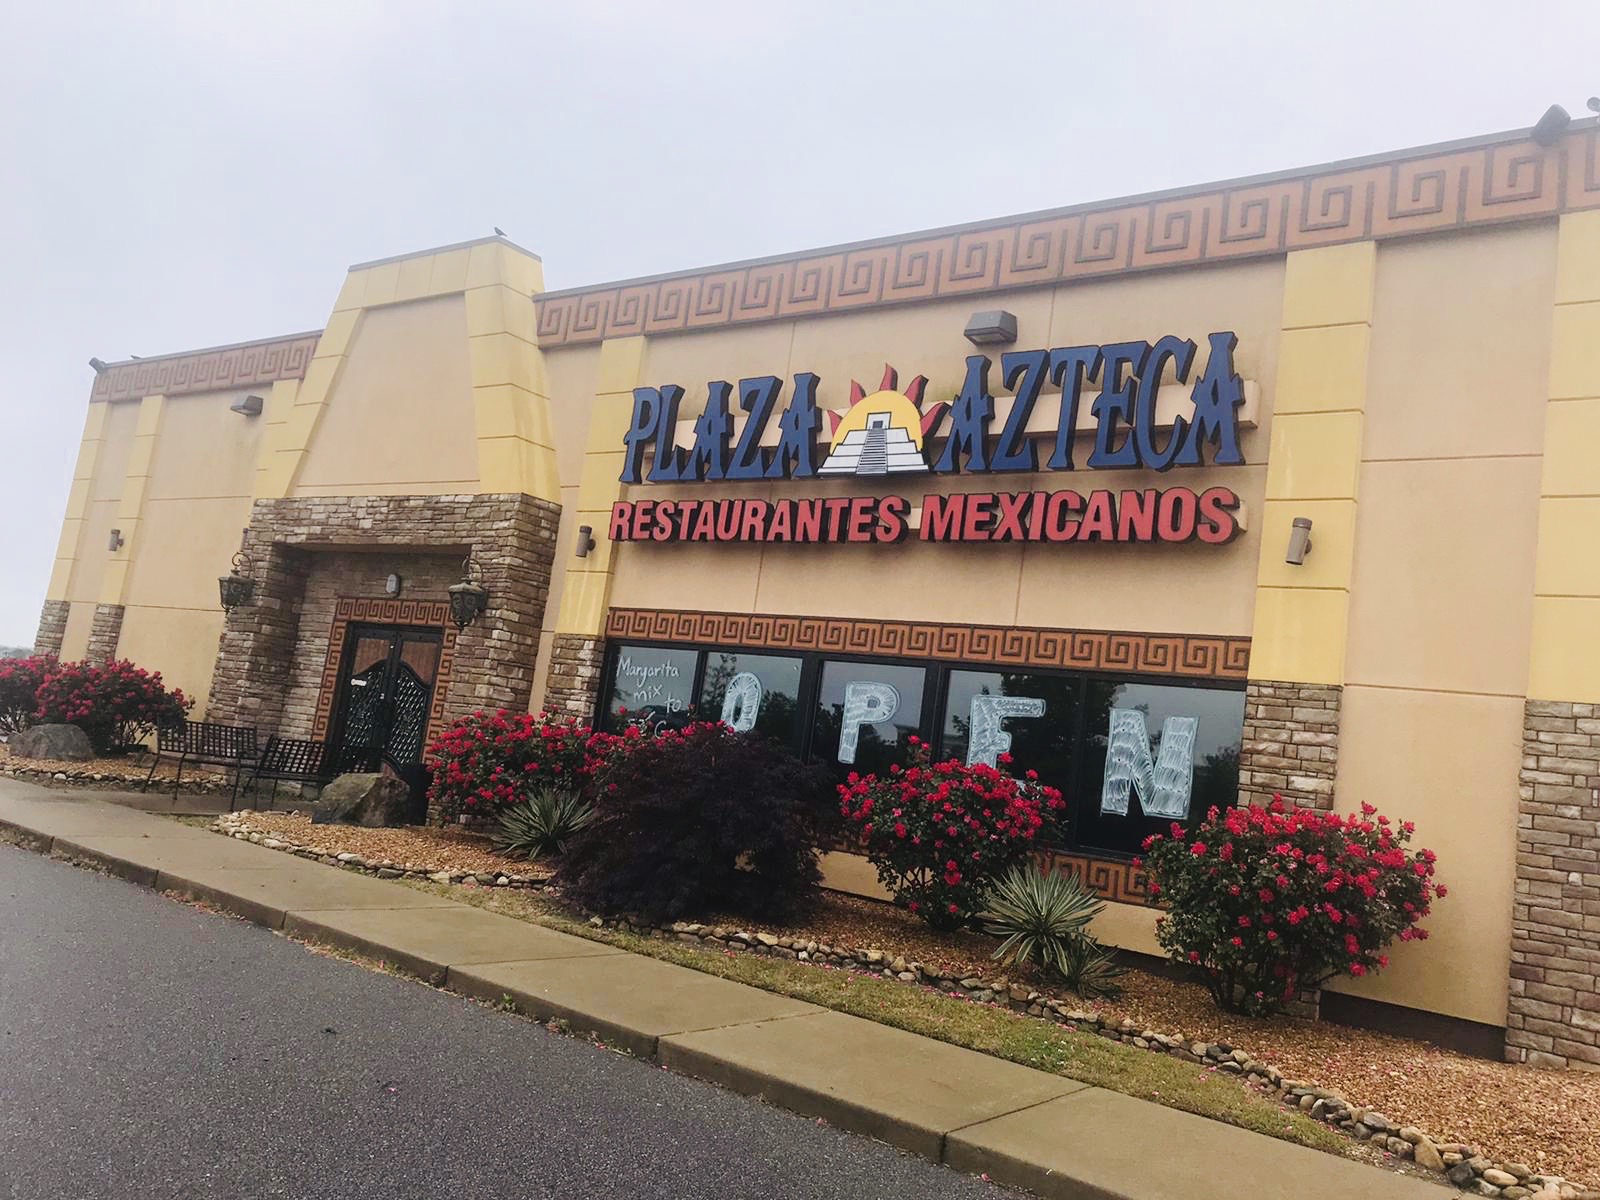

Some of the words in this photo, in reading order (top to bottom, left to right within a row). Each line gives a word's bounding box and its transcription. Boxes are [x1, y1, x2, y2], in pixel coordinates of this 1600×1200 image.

[619, 372, 821, 482] PLAZA
[934, 331, 1246, 473] AZTECA
[608, 495, 908, 543] RESTAURANTES
[919, 486, 1240, 545] MEXICANOS
[616, 655, 680, 688] Margarita
[633, 684, 662, 702] mix
[664, 692, 682, 713] to
